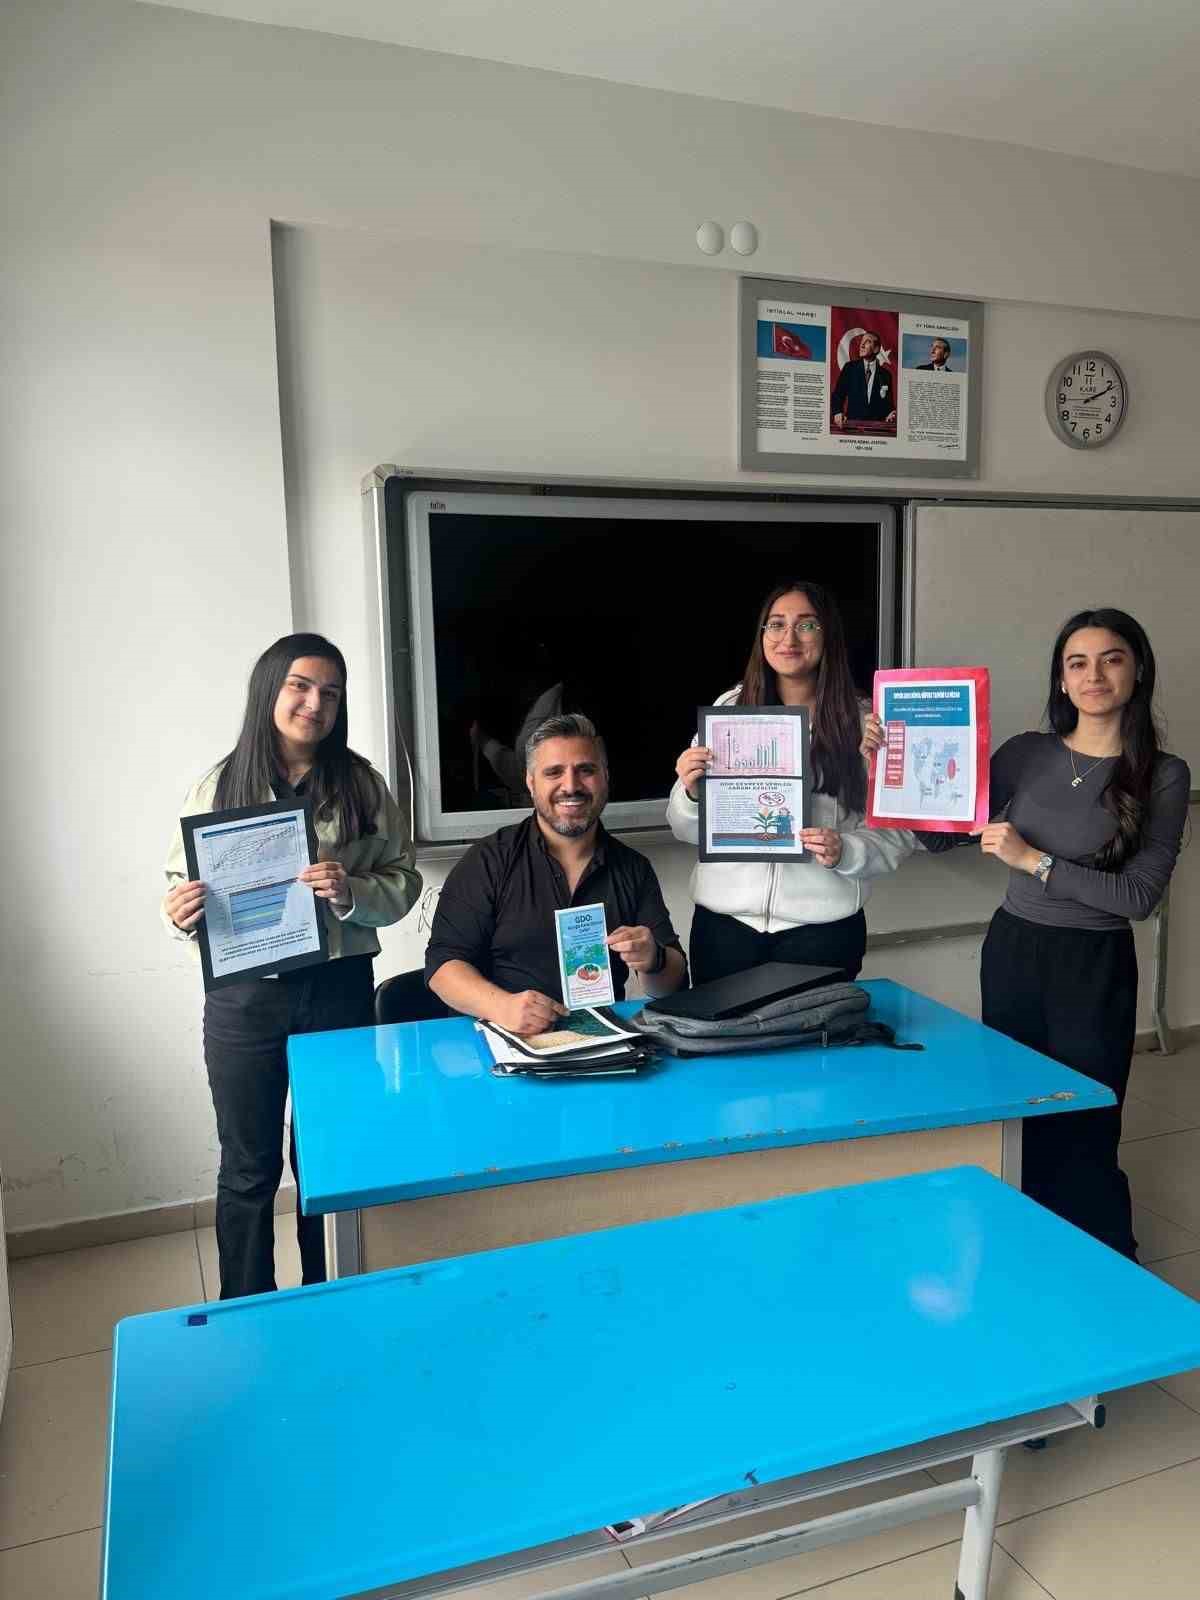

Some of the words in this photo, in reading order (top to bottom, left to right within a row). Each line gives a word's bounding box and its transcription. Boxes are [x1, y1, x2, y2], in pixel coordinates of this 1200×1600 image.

[1073, 365, 1081, 375] 11
[1086, 361, 1096, 372] 12
[1064, 377, 1073, 387] 10
[1106, 380, 1113, 390] 2
[1059, 393, 1067, 405] 9
[1110, 396, 1117, 408] 3
[1062, 410, 1070, 421] 8
[1104, 413, 1112, 423] 4
[1070, 422, 1077, 432] 7
[1096, 423, 1103, 434] 5
[1083, 429, 1090, 440] 6
